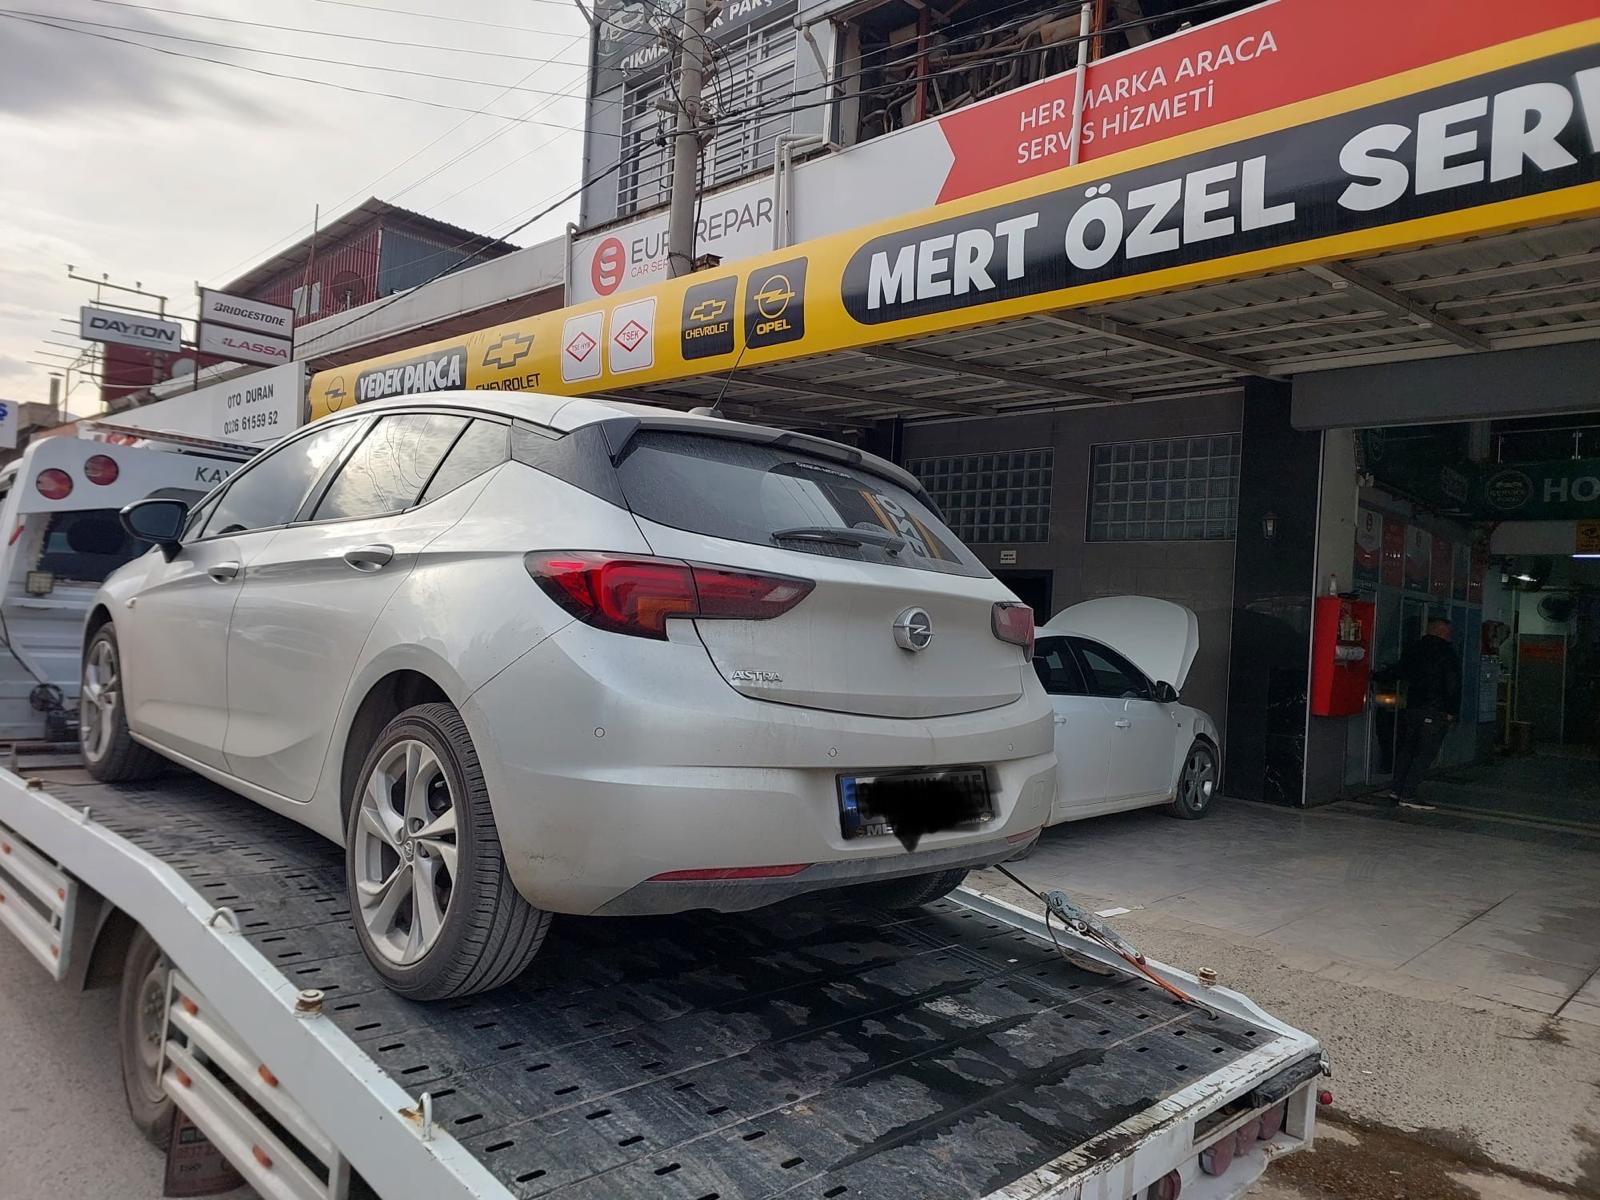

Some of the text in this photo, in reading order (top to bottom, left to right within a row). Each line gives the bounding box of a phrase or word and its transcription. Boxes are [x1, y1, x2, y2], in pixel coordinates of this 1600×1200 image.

[1020, 99, 1066, 132] HER
[1175, 31, 1278, 83] ARACA
[1017, 79, 1215, 164] SERVS HİZMETİ
[867, 212, 1039, 310] MERT
[1064, 155, 1296, 270] ÖZEL
[631, 265, 649, 278] CAR
[214, 302, 286, 327] BRIDGESTONE
[756, 319, 791, 335] OPEL
[90, 316, 175, 341] DAYTON
[622, 330, 640, 342] TSEK
[685, 322, 729, 340] CHEVROLET
[226, 338, 288, 358] LASSA
[360, 354, 461, 400] YEDEK PARÇA
[227, 384, 274, 409] OTO DURAN
[731, 670, 783, 683] ASTRA
